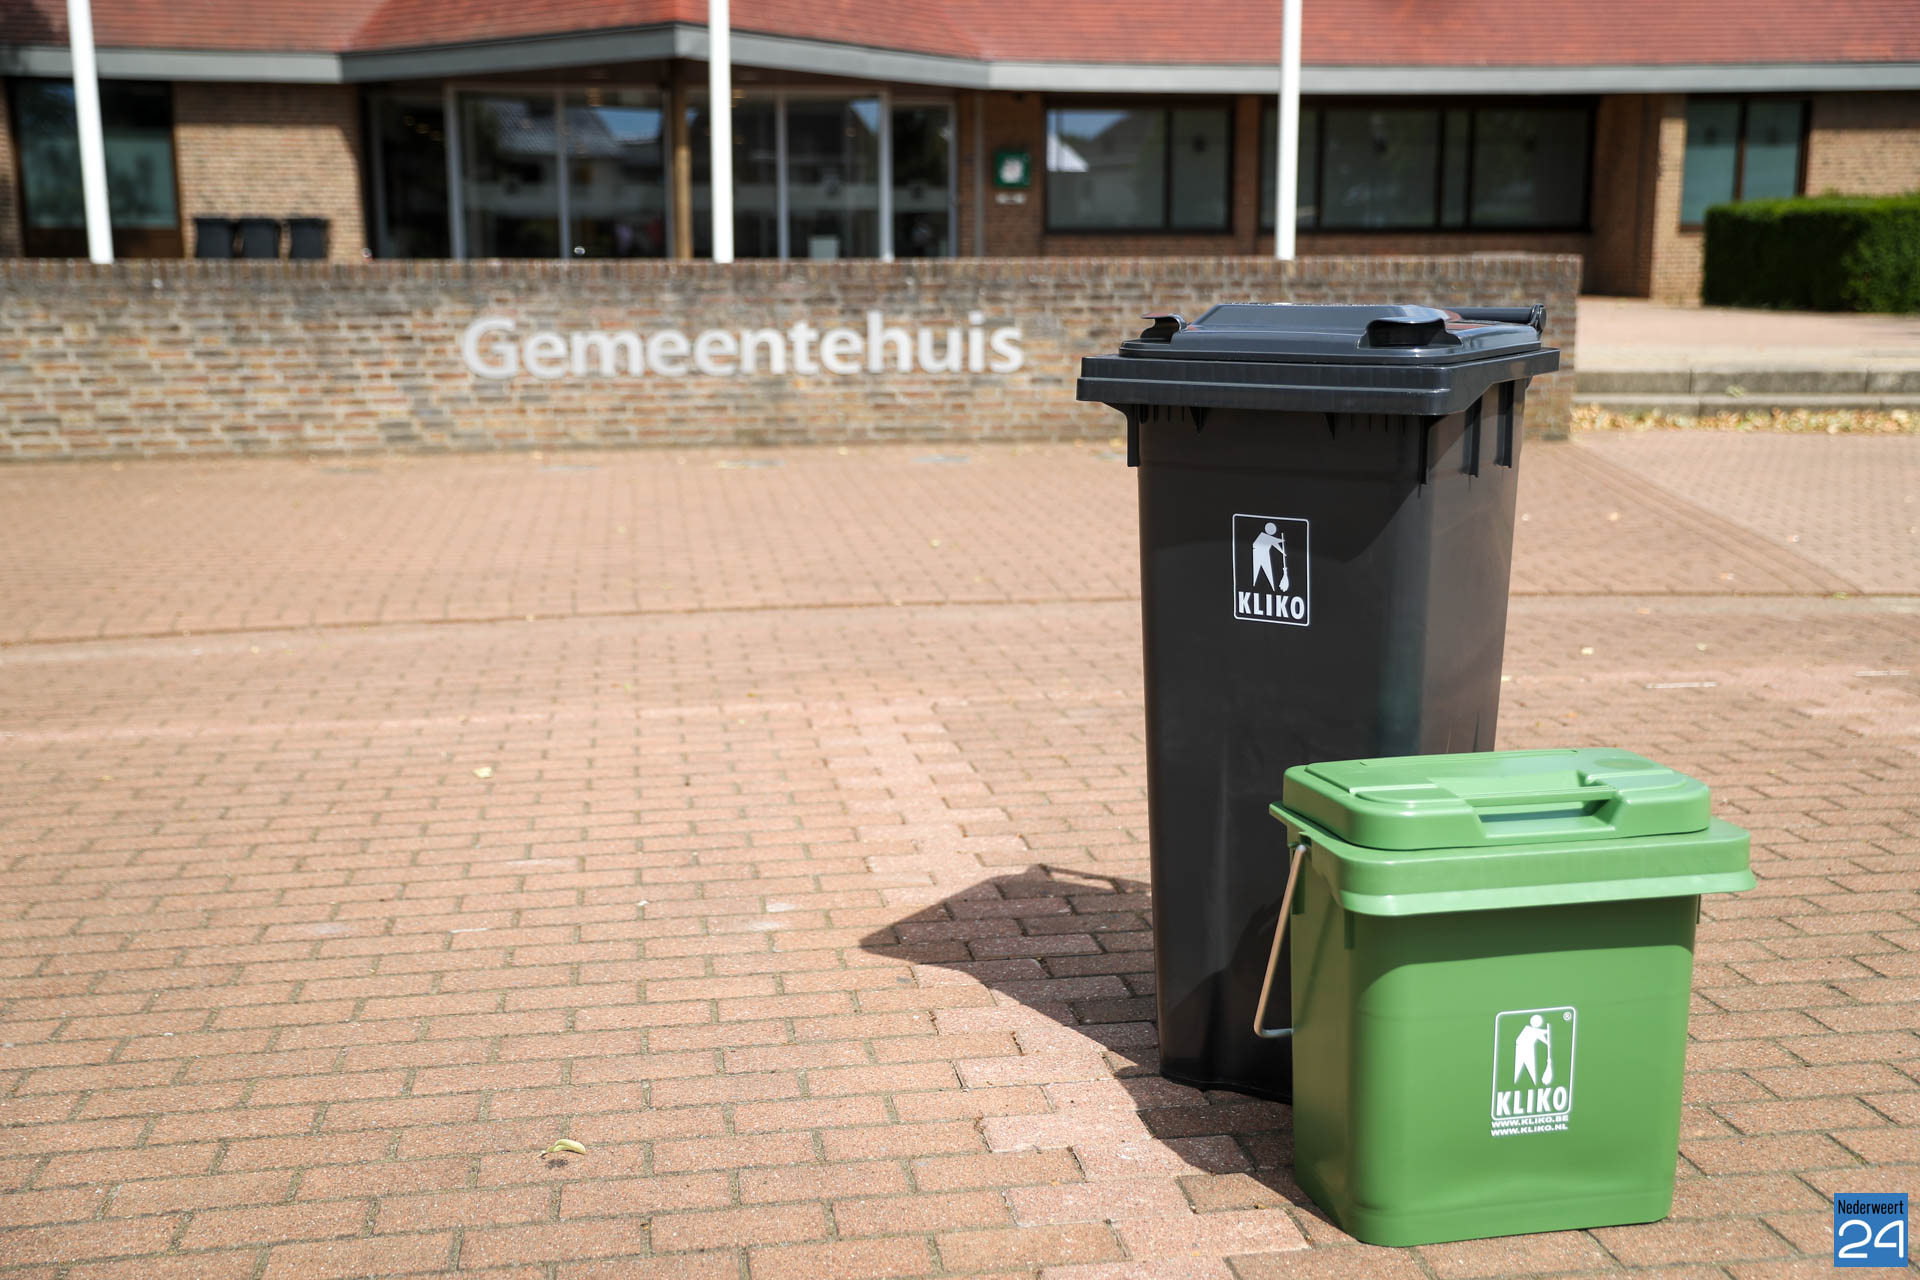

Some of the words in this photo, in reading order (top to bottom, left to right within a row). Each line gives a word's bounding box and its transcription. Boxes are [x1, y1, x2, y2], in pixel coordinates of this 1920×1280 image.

[461, 310, 1025, 379] Gemeentehuis
[1238, 591, 1305, 620] KLIKO
[1496, 1086, 1567, 1116] KLIKO
[1491, 1115, 1569, 1128] WWW.KLIKO.BE
[1491, 1124, 1569, 1136] WWW.KLIKO.NL
